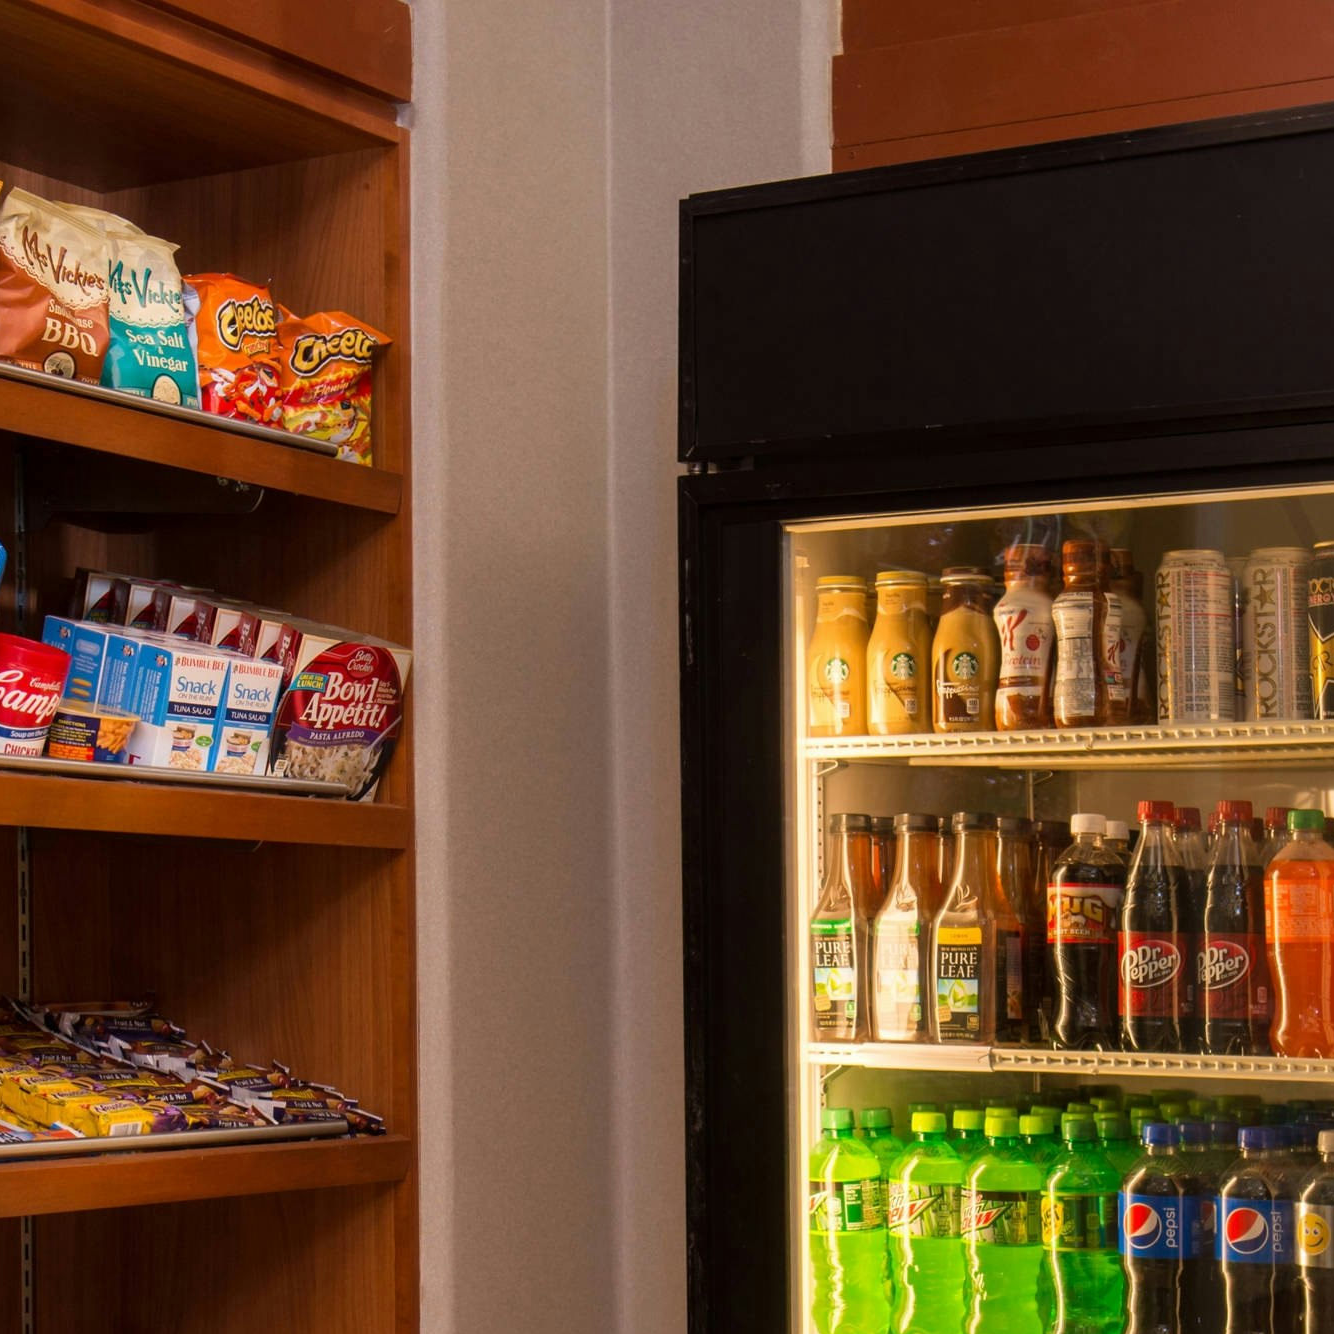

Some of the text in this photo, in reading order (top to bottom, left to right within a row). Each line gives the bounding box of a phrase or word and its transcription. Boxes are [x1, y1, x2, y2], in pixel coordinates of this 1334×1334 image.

[46, 247, 105, 292] Vickie's
[216, 296, 275, 351] Cheetos
[40, 317, 99, 358] BBQ
[125, 328, 184, 349] Sea Salt
[133, 349, 188, 374] Vinegar
[181, 656, 226, 671] BUMBLE BEE
[356, 650, 374, 666] Betty
[238, 664, 280, 679] BUMBLE BEE
[176, 677, 216, 696] Snack
[234, 683, 271, 702] Snack
[296, 678, 324, 690] LUNCH!
[323, 672, 380, 703] Bowl
[173, 705, 212, 716] TUNA SALAD
[231, 712, 267, 722] TUNA SALAD
[300, 693, 386, 731] Appétit!
[310, 730, 365, 741] PASTA ALFREDO
[815, 941, 851, 954] PURE
[1138, 945, 1161, 962] Dr
[816, 954, 849, 967] LEAF
[941, 952, 977, 965] PURE
[1121, 951, 1177, 984] Pepper
[1197, 951, 1244, 985] Pepper
[940, 965, 975, 978] LEAF
[1164, 1207, 1178, 1248] pepsi
[1271, 1210, 1283, 1252] pepsi
